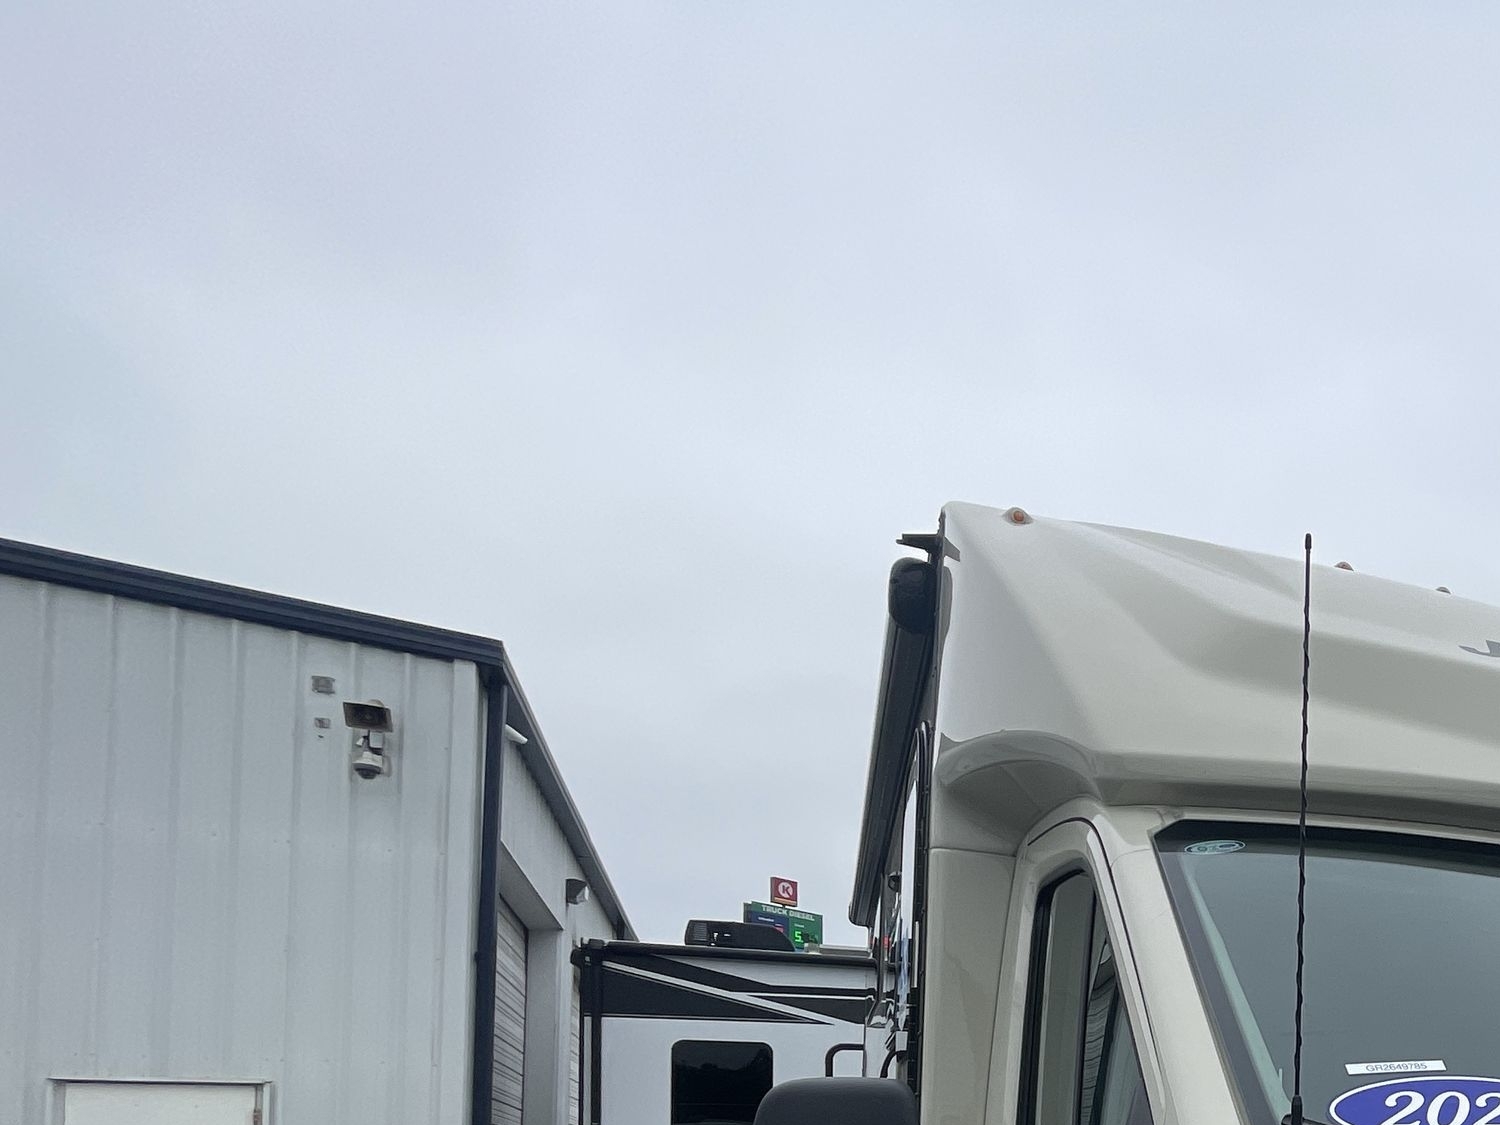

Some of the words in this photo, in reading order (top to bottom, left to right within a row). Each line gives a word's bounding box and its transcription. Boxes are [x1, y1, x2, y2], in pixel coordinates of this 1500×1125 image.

[782, 884, 792, 898] K
[761, 904, 788, 916] TRUCK
[1365, 1063, 1428, 1072] GR2649785
